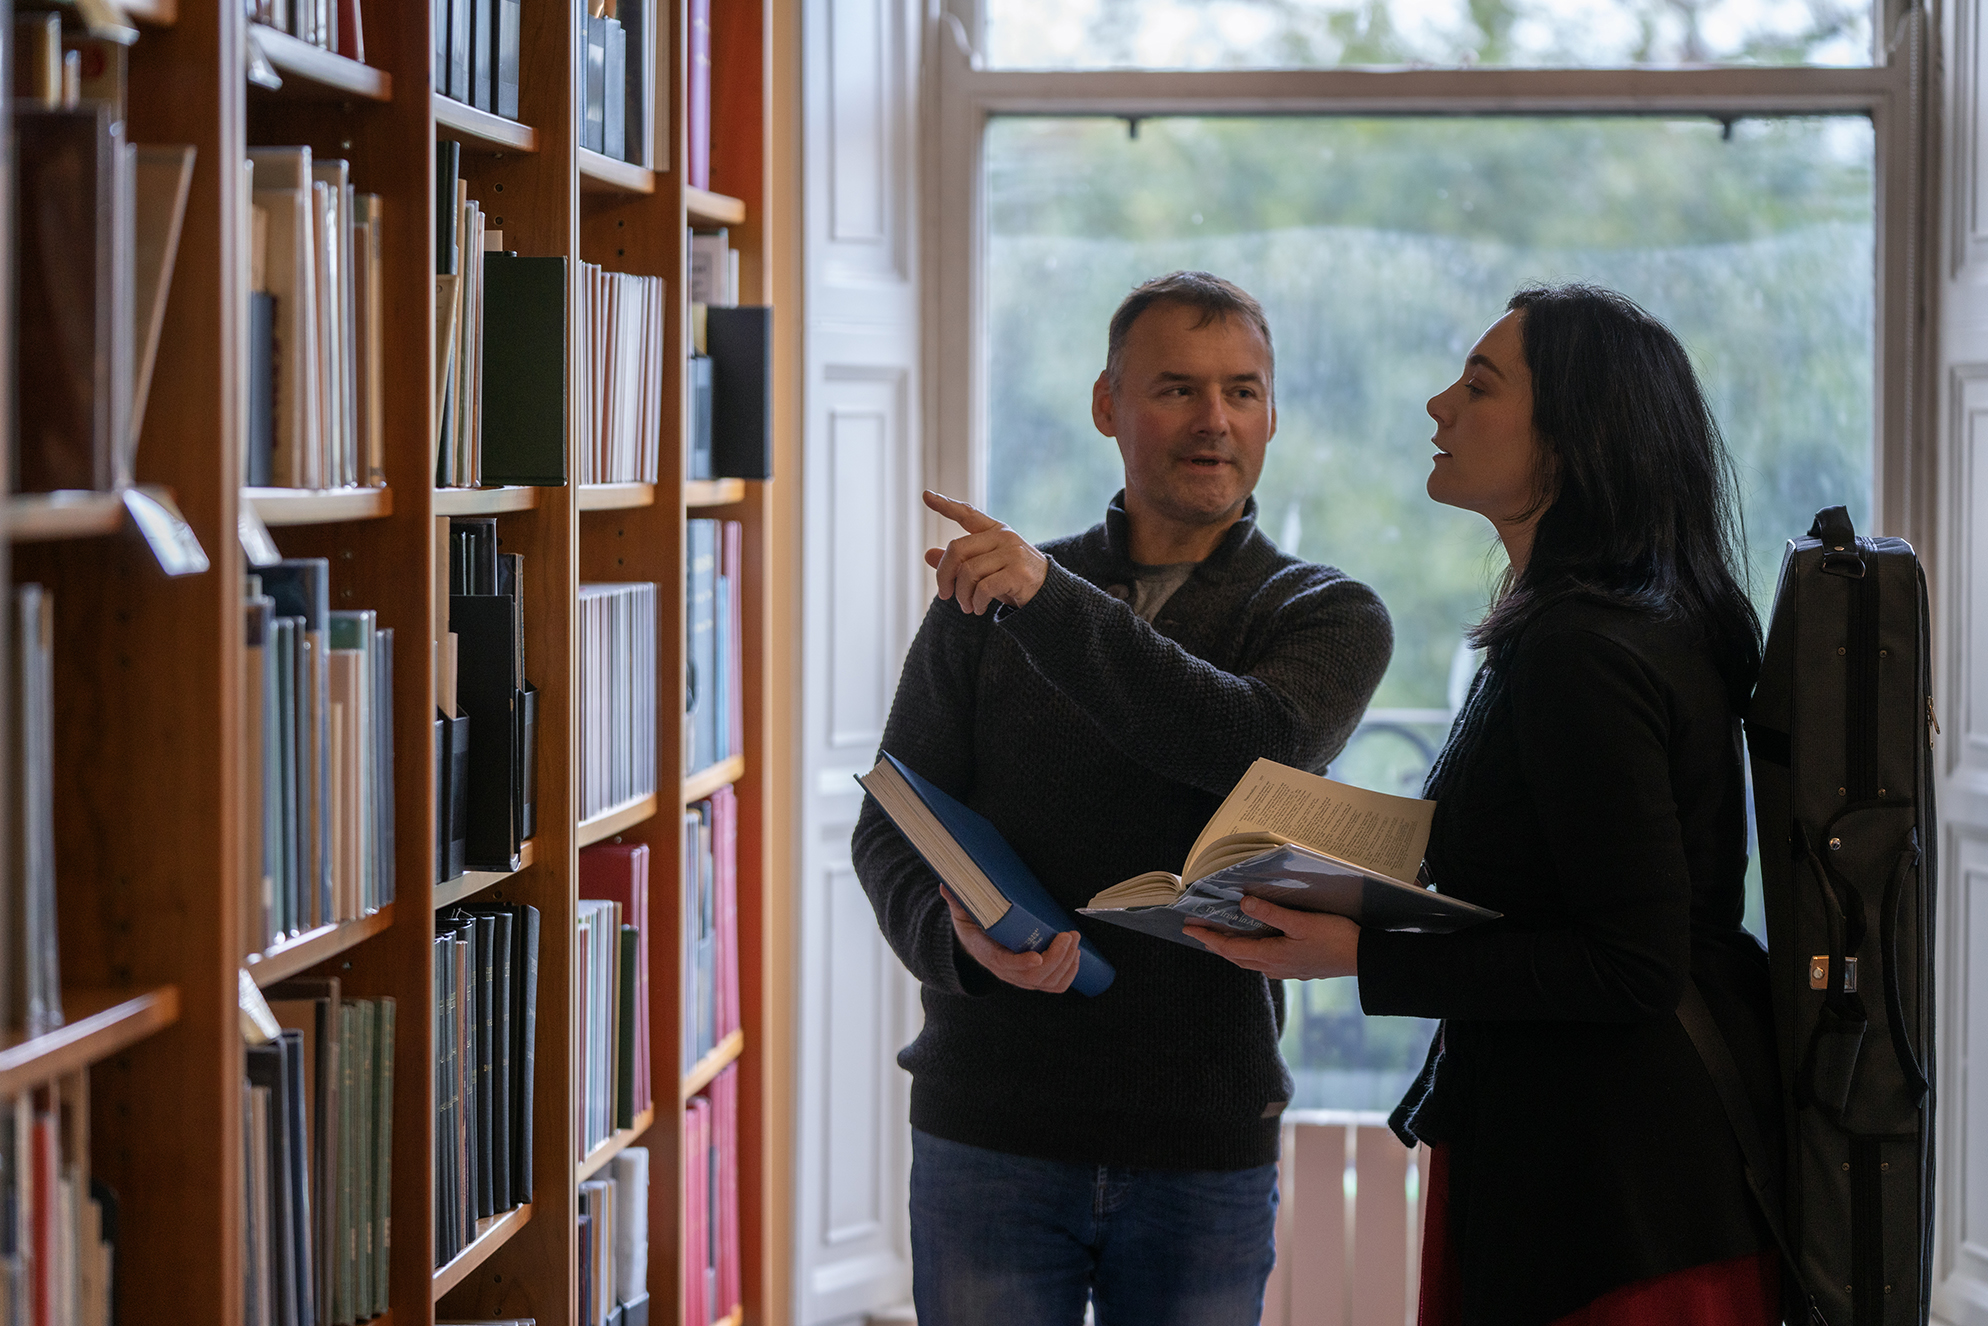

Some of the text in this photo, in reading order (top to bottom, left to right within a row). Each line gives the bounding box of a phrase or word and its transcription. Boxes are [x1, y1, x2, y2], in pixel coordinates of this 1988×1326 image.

[1205, 904, 1221, 915] The
[1220, 910, 1240, 921] Irish
[1239, 914, 1248, 924] in
[1247, 918, 1276, 932] Americ
